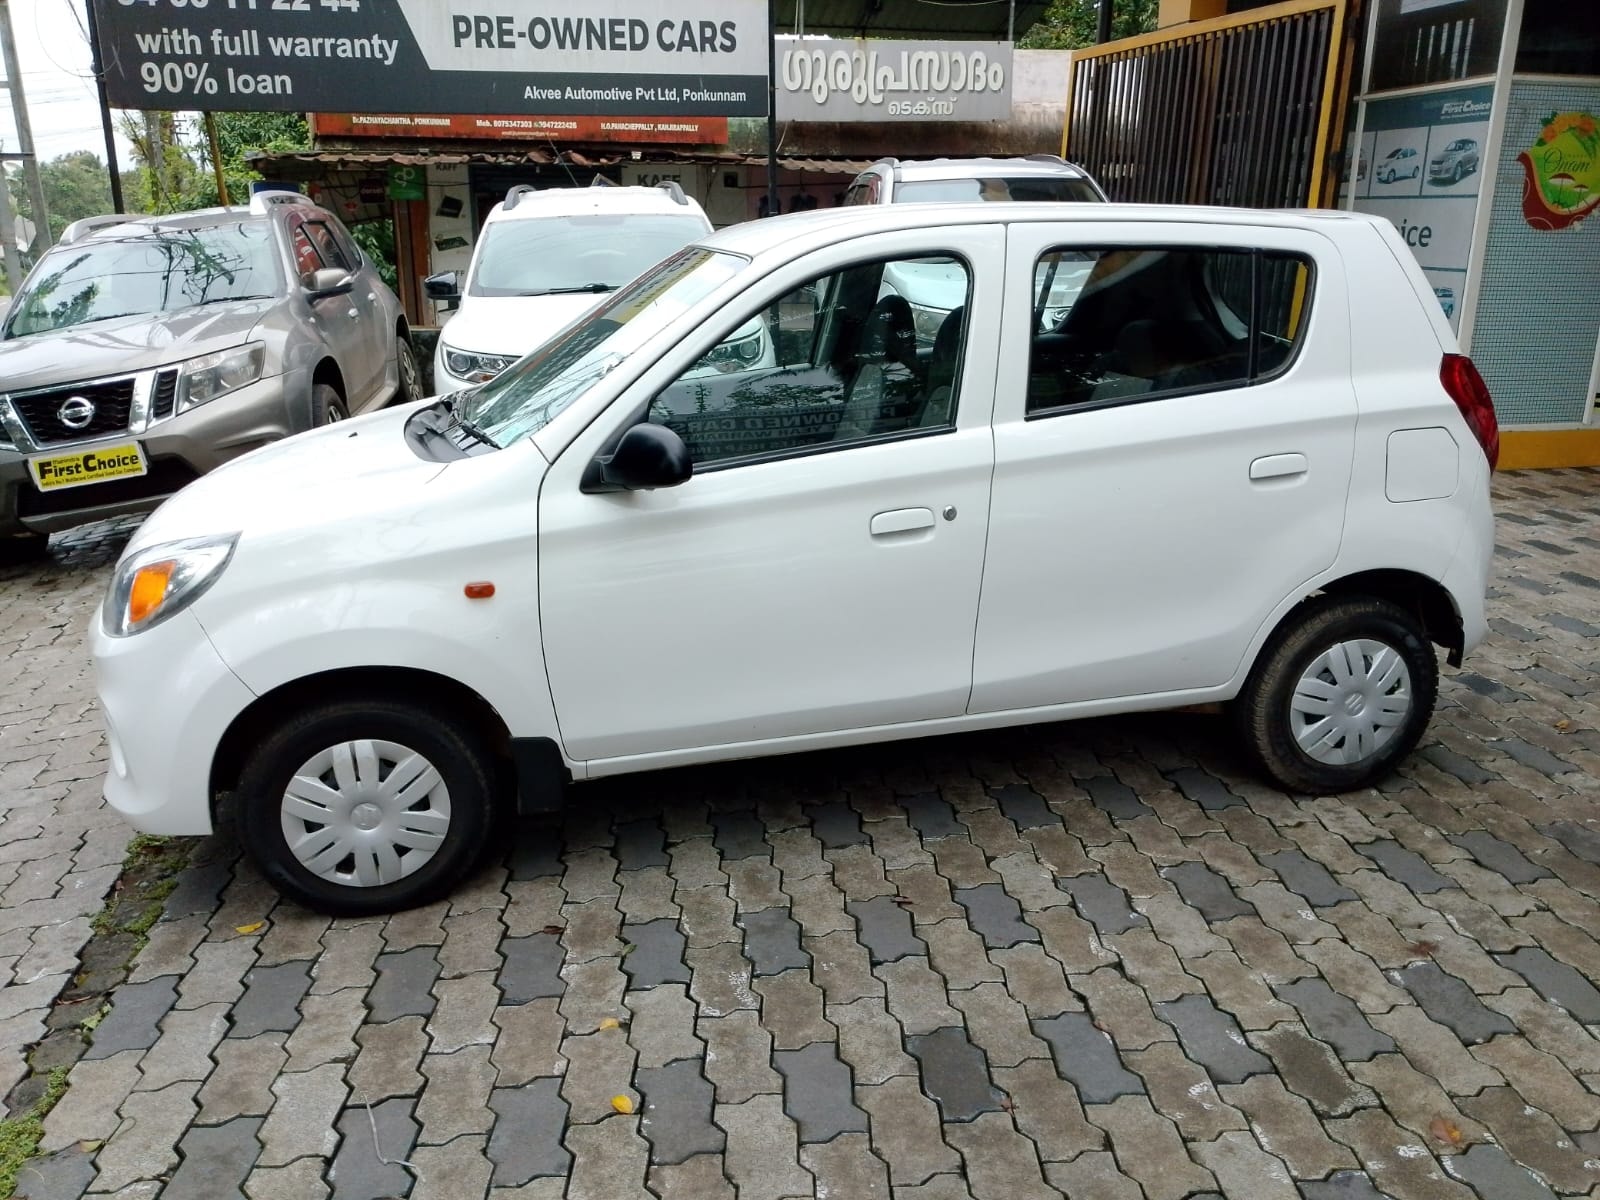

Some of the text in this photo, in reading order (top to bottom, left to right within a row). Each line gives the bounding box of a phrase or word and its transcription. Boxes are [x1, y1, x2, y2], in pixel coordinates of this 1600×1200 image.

[135, 28, 399, 65] with full warranty
[452, 15, 738, 53] PRE-OWNED CARS
[140, 62, 293, 95] 90% loan
[782, 48, 1004, 104] ഗുരുപ്രസാദം
[523, 86, 747, 103] Akvee Automotive Pvt Ltd, Ponkunnam
[38, 454, 139, 479] First Choice
